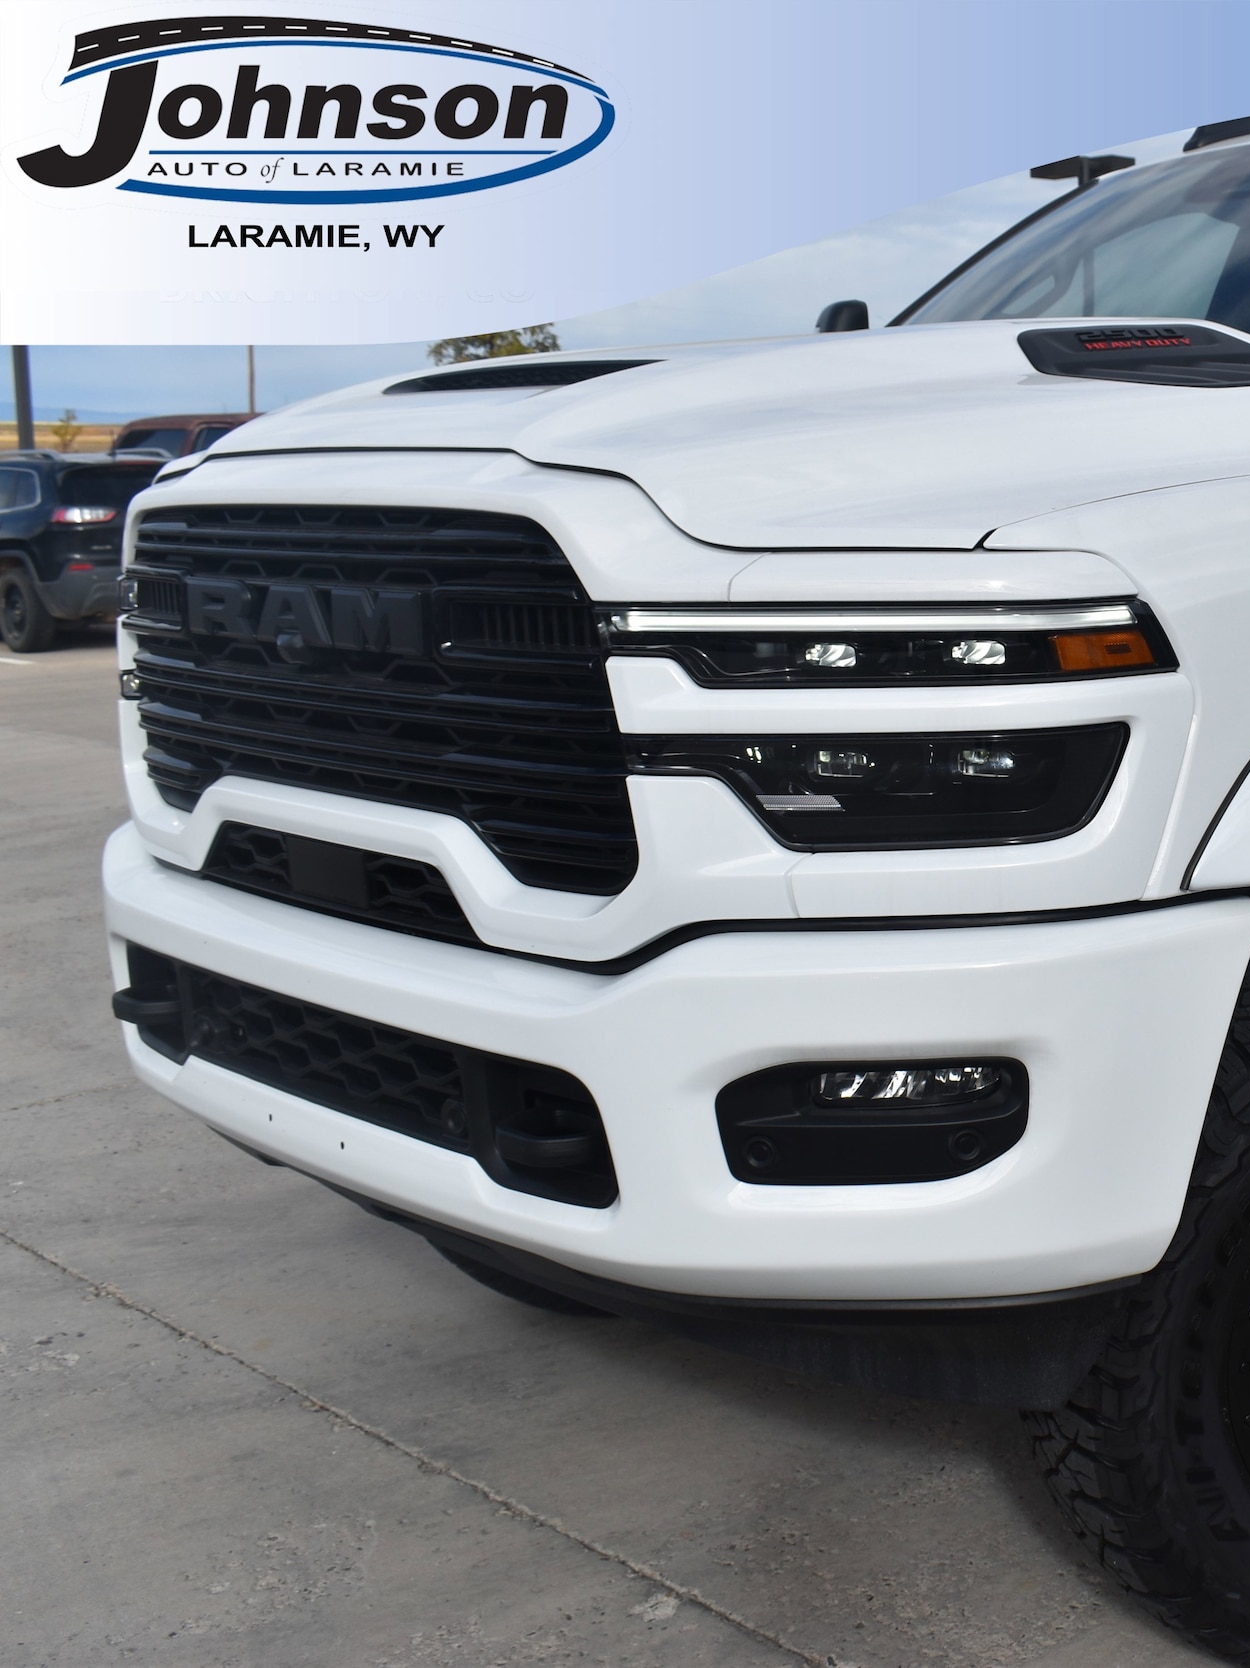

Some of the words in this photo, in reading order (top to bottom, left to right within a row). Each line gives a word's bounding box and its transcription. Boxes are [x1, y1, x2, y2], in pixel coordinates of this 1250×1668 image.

[1075, 327, 1184, 342] 2500
[1084, 339, 1142, 351] HEAVY
[1145, 337, 1191, 348] DUTY
[187, 576, 424, 655] RAM
